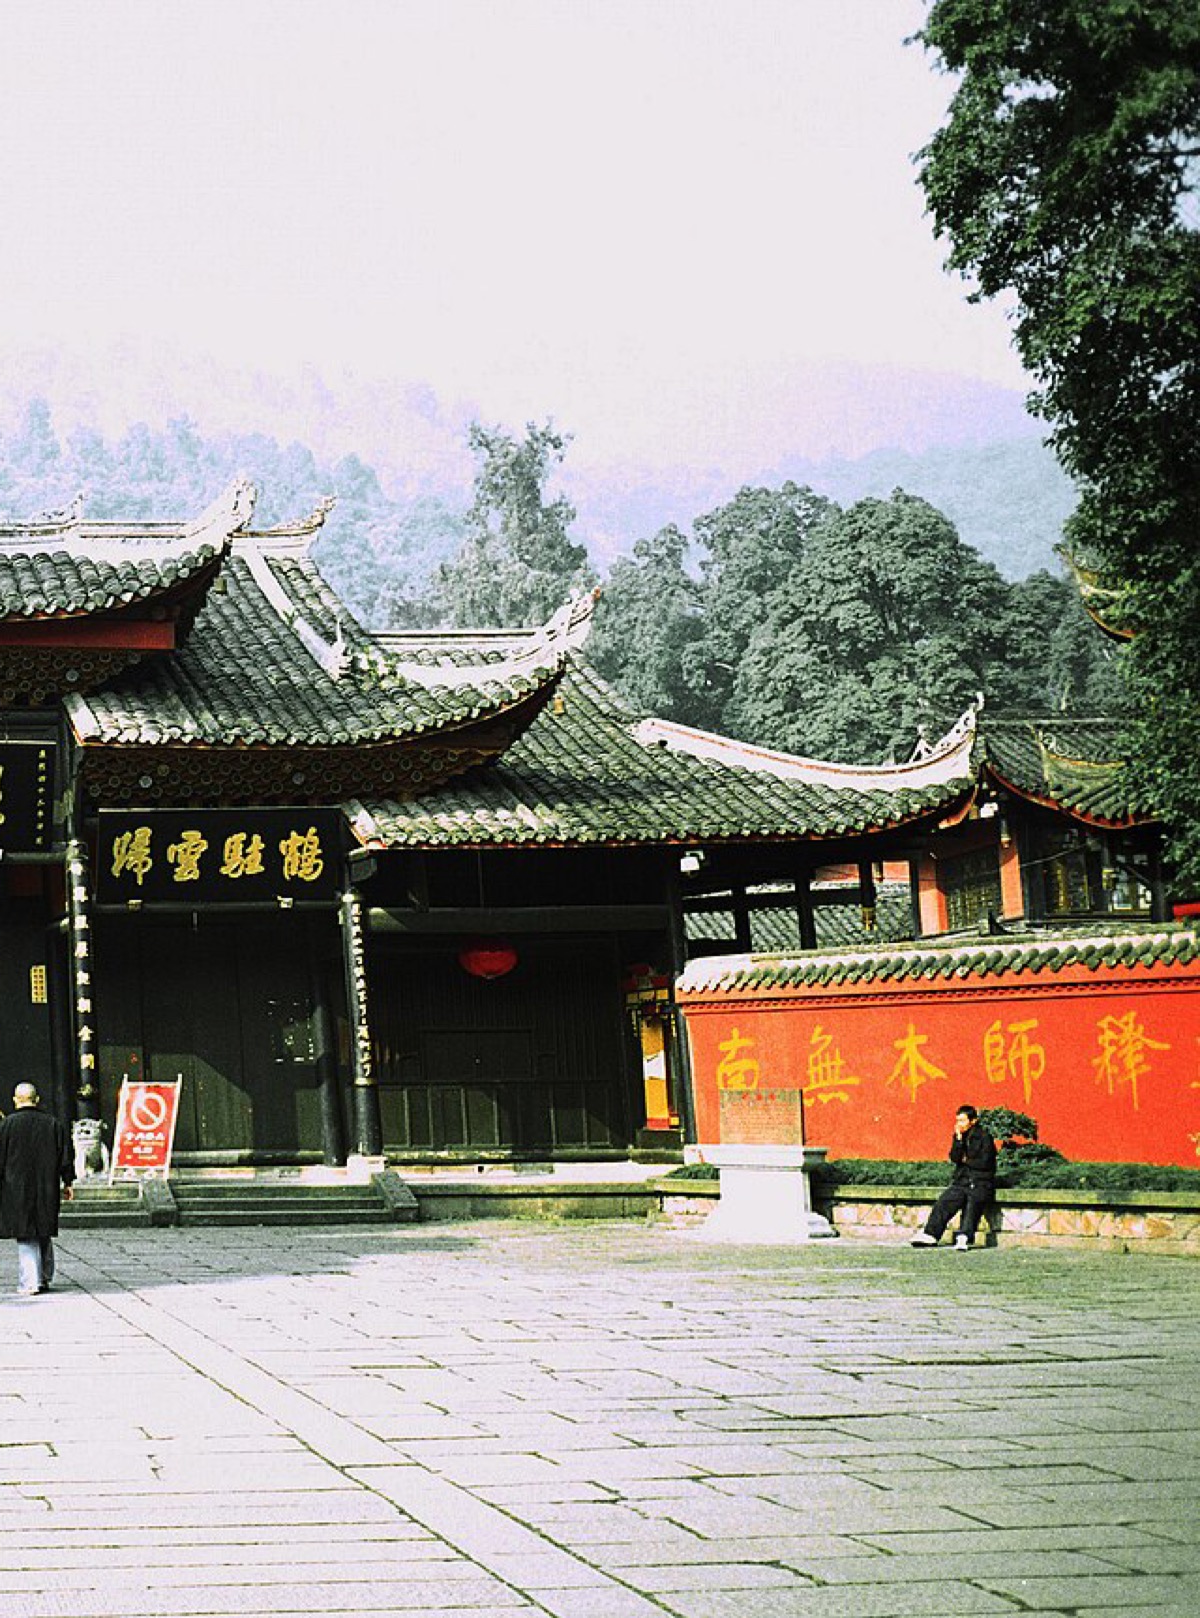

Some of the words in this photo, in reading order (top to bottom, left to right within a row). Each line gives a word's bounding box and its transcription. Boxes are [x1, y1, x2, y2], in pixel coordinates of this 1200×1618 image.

[715, 1010, 1200, 1112] 南無本師釋
